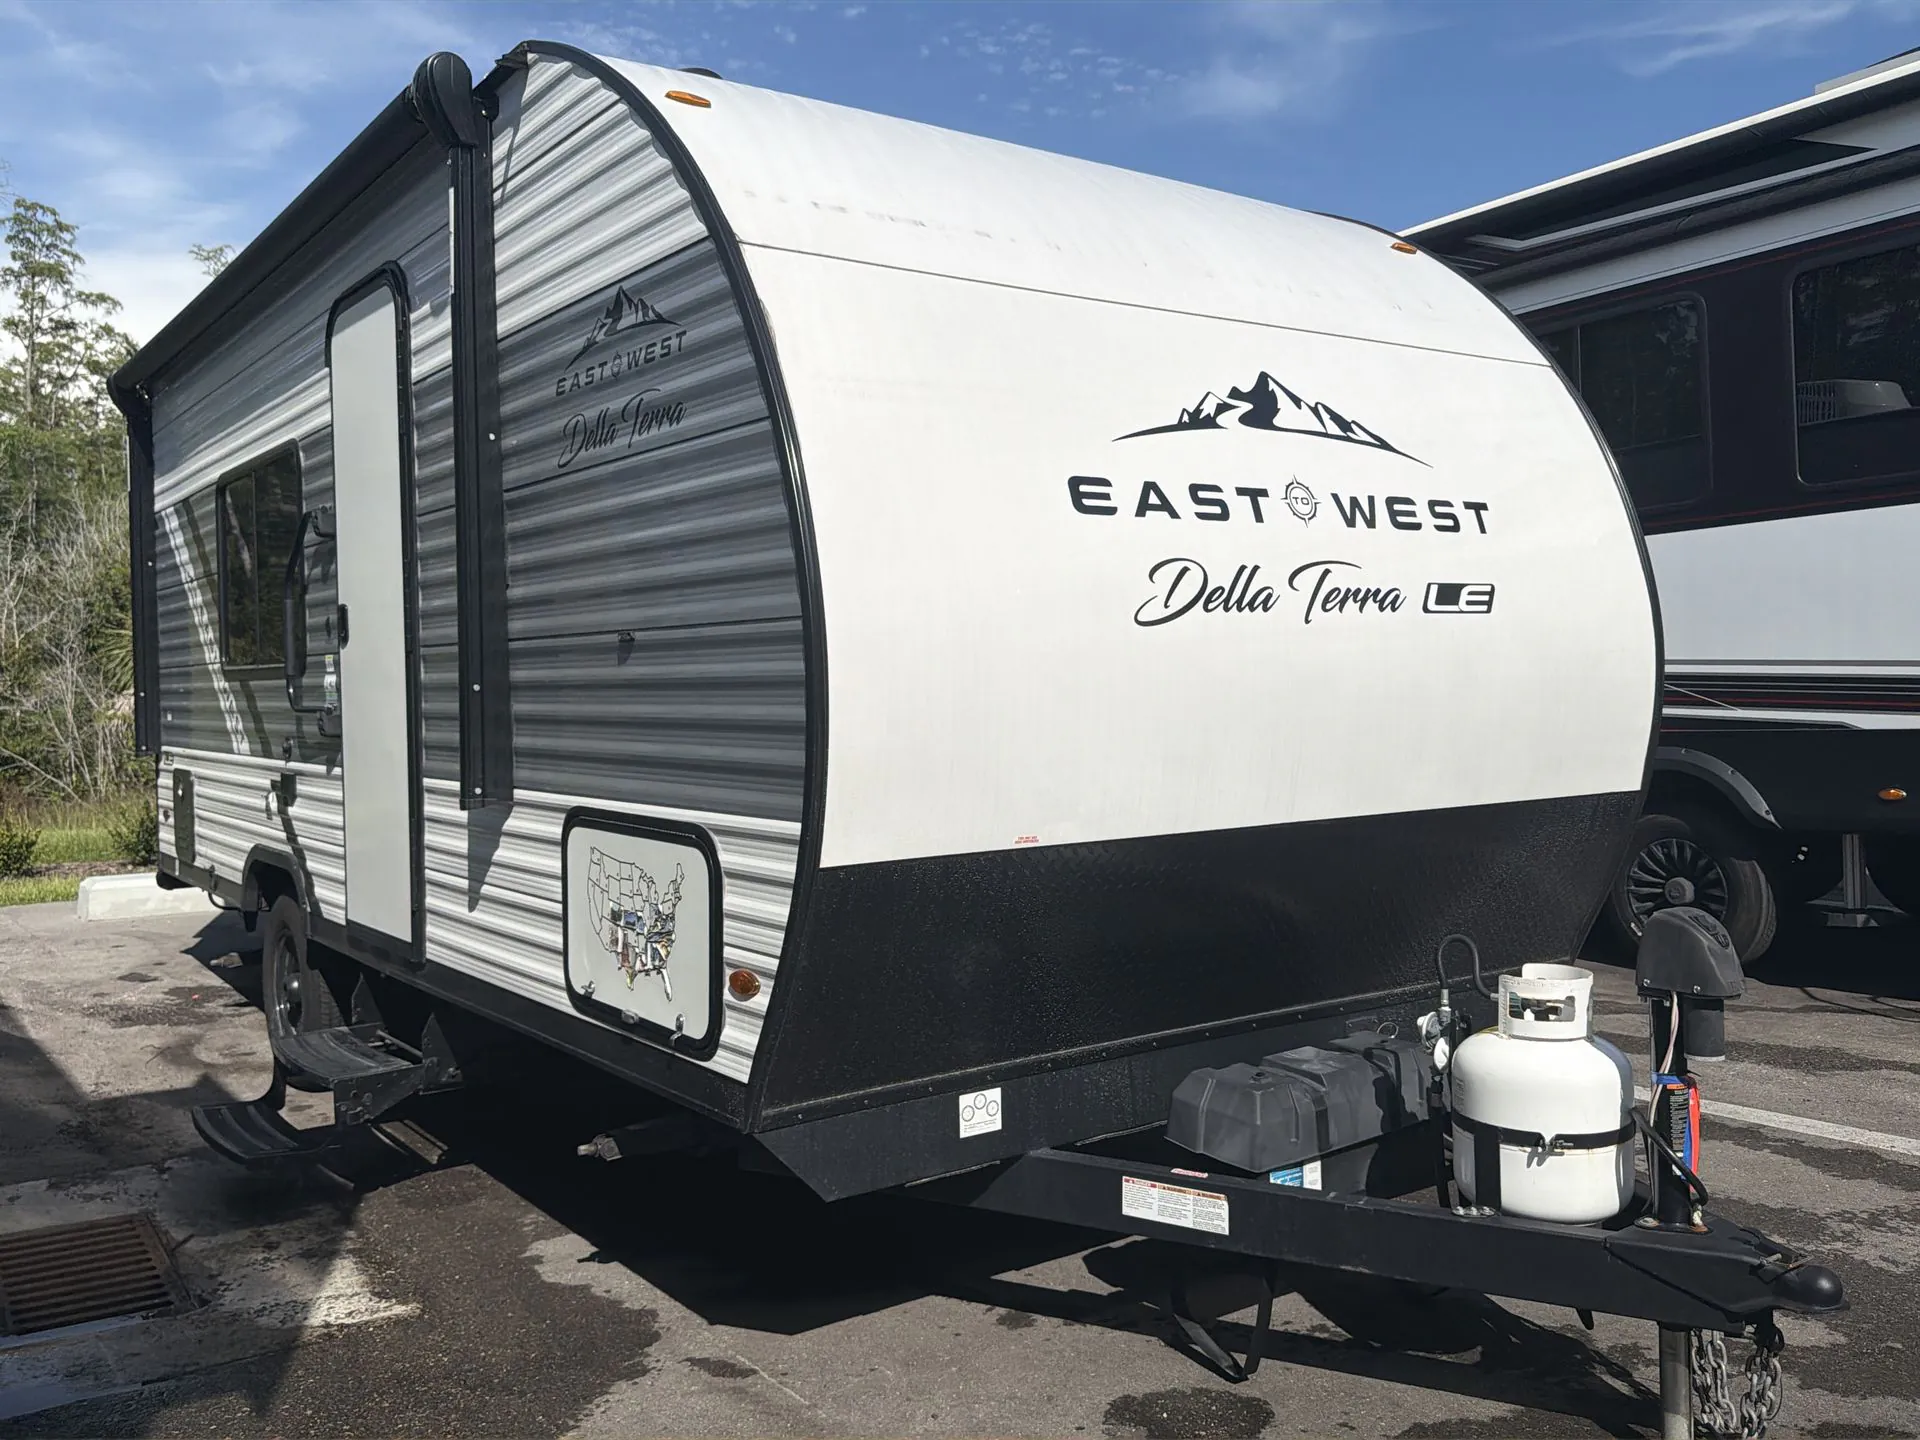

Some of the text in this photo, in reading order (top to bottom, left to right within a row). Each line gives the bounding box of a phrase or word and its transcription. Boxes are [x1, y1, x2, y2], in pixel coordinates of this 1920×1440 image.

[555, 329, 688, 397] EAST WEST
[557, 388, 688, 469] Della Terra
[1067, 475, 1489, 534] EAST TO WEST
[1133, 557, 1494, 627] Della Terra LE
